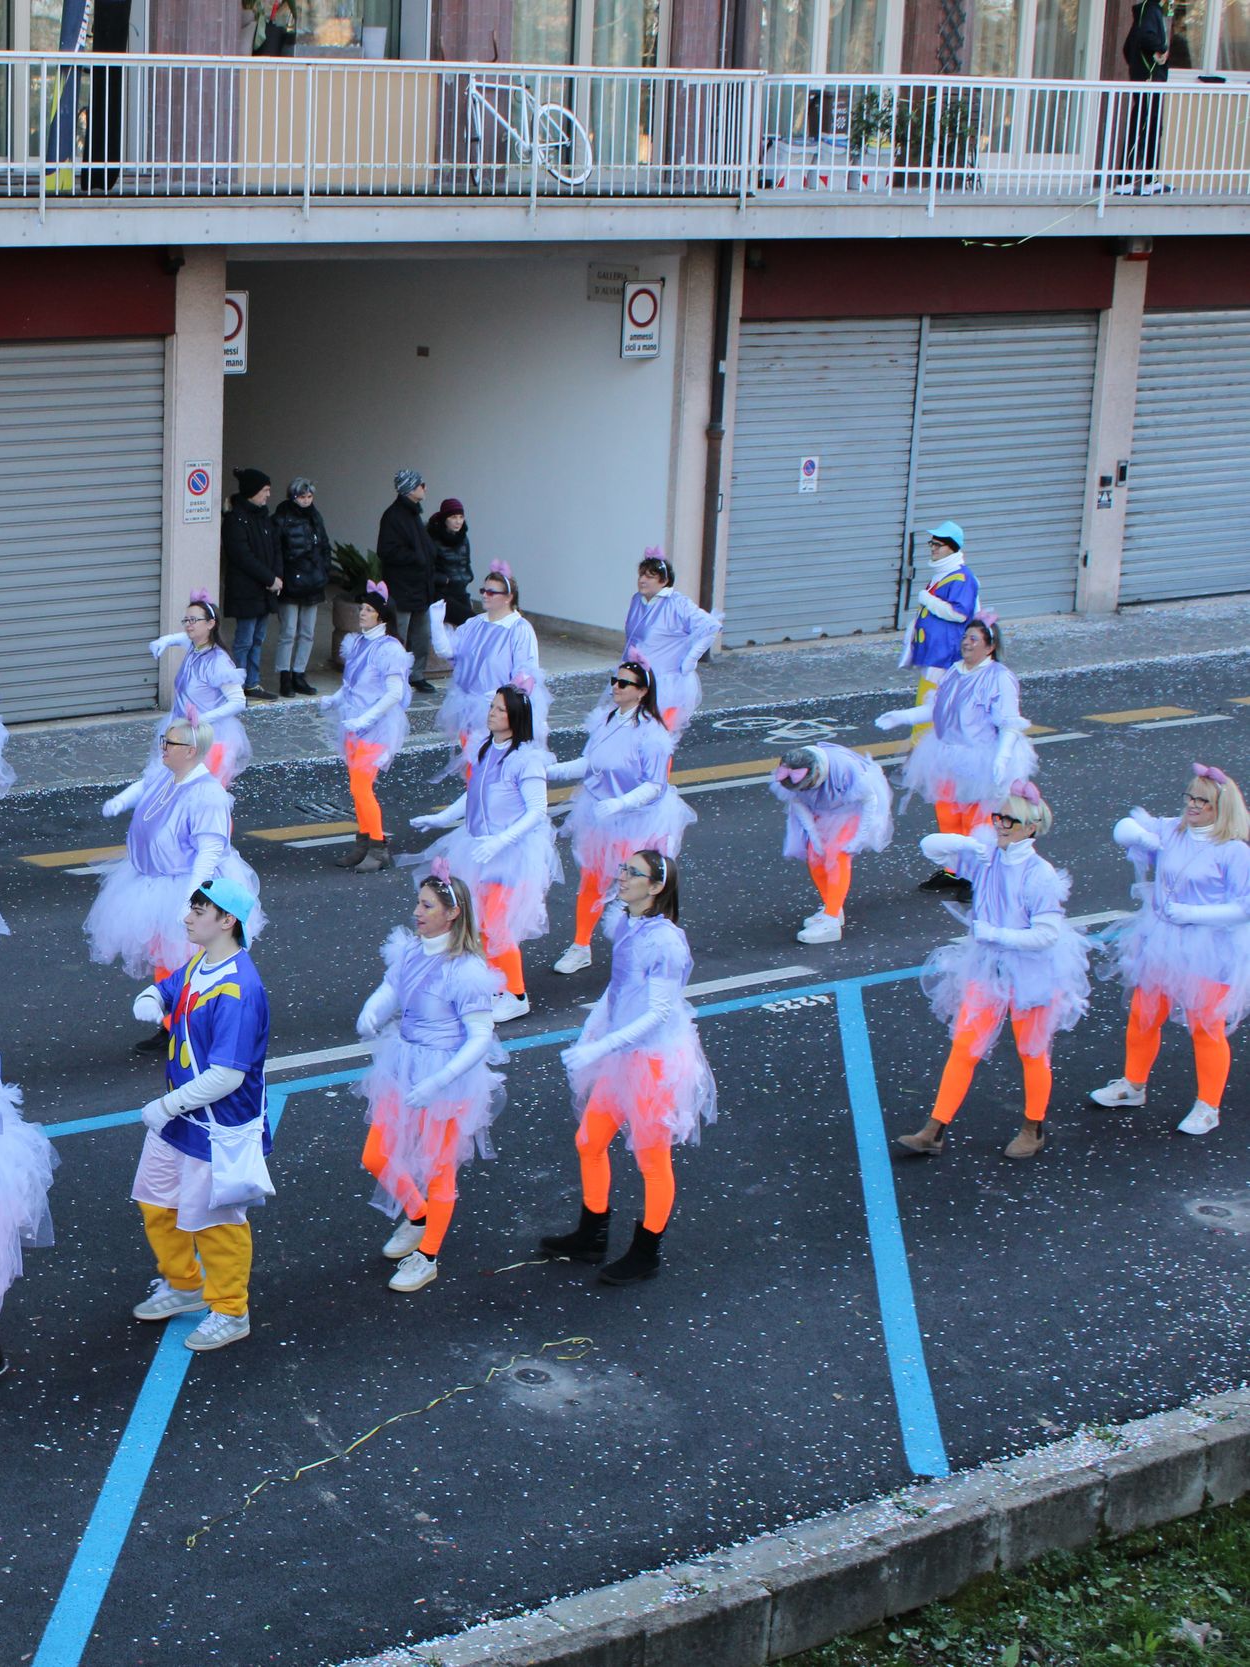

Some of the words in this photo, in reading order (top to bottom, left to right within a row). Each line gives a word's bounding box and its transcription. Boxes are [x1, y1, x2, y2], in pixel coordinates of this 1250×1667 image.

[630, 332, 653, 341] ammessi
[223, 346, 238, 355] essi
[625, 343, 637, 352] cicli
[642, 343, 657, 351] mano
[225, 359, 244, 367] mano
[185, 506, 210, 514] carrabile
[761, 994, 832, 1013] 4223
